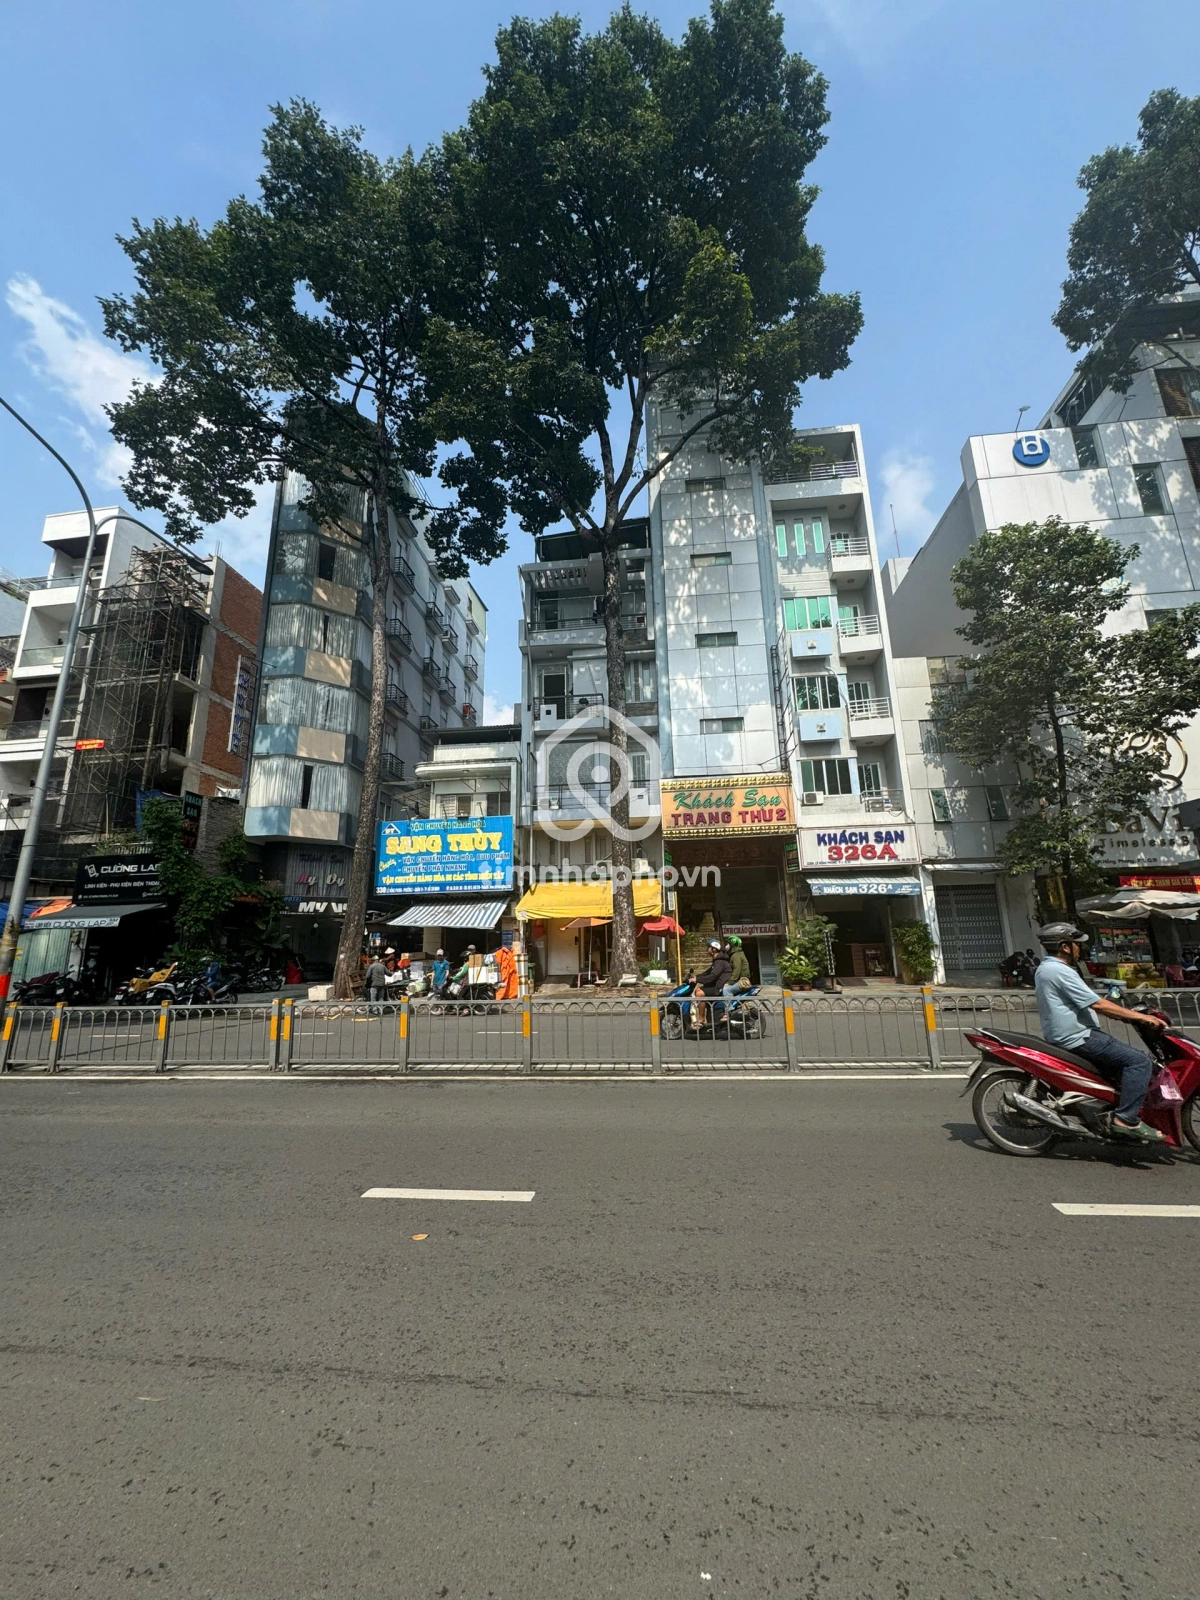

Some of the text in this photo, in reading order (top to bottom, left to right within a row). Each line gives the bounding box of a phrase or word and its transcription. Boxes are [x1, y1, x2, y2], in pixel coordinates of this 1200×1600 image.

[673, 788, 782, 811] Khách Sạn
[671, 811, 732, 826] TRANG
[775, 808, 787, 821] 2
[386, 828, 503, 855] SANG THÙY
[817, 830, 905, 846] KHÁCH SẠN
[1098, 837, 1176, 848] Timeless
[828, 844, 899, 861] 326A
[402, 854, 416, 865] VẬN
[416, 853, 441, 863] CHUYỂN
[101, 862, 138, 874] CƯỜNG
[402, 863, 426, 873] CHUYỂN
[445, 863, 467, 871] NHANH
[298, 901, 328, 913] MY
[87, 919, 107, 928] LAP
